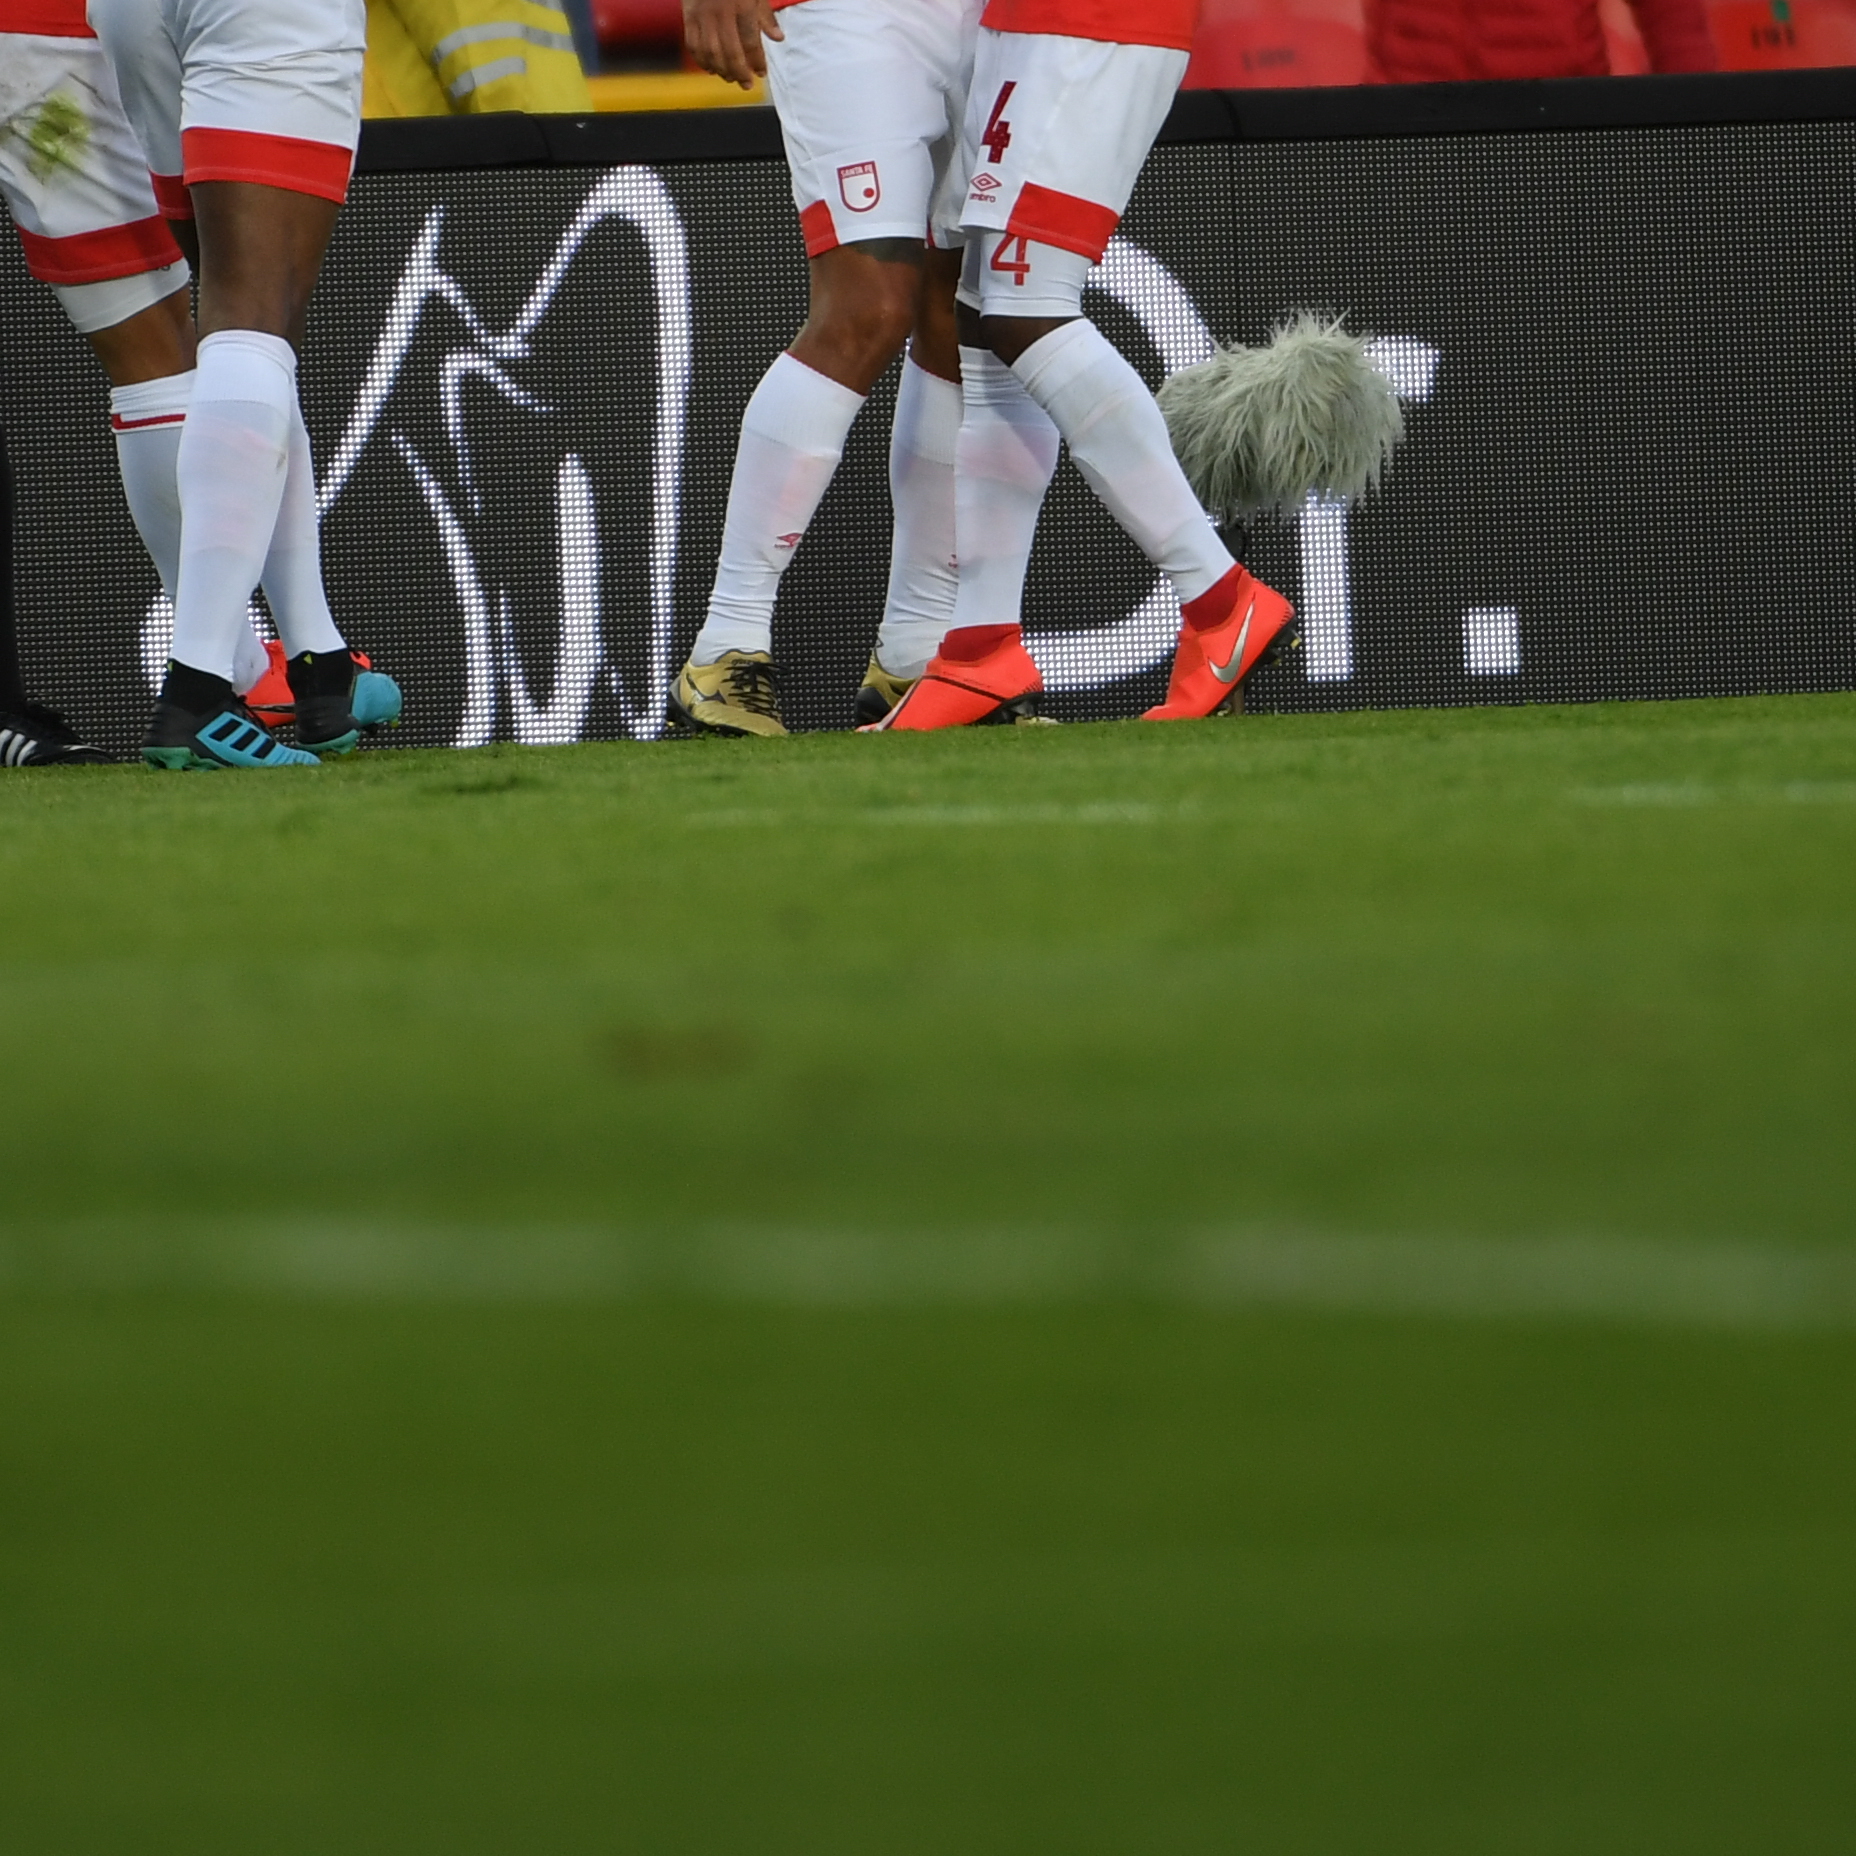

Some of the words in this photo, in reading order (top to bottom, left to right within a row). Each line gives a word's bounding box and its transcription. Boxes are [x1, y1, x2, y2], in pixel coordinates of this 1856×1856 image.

[982, 81, 1017, 163] 4
[840, 165, 863, 178] SANTA
[991, 234, 1030, 286] 4
